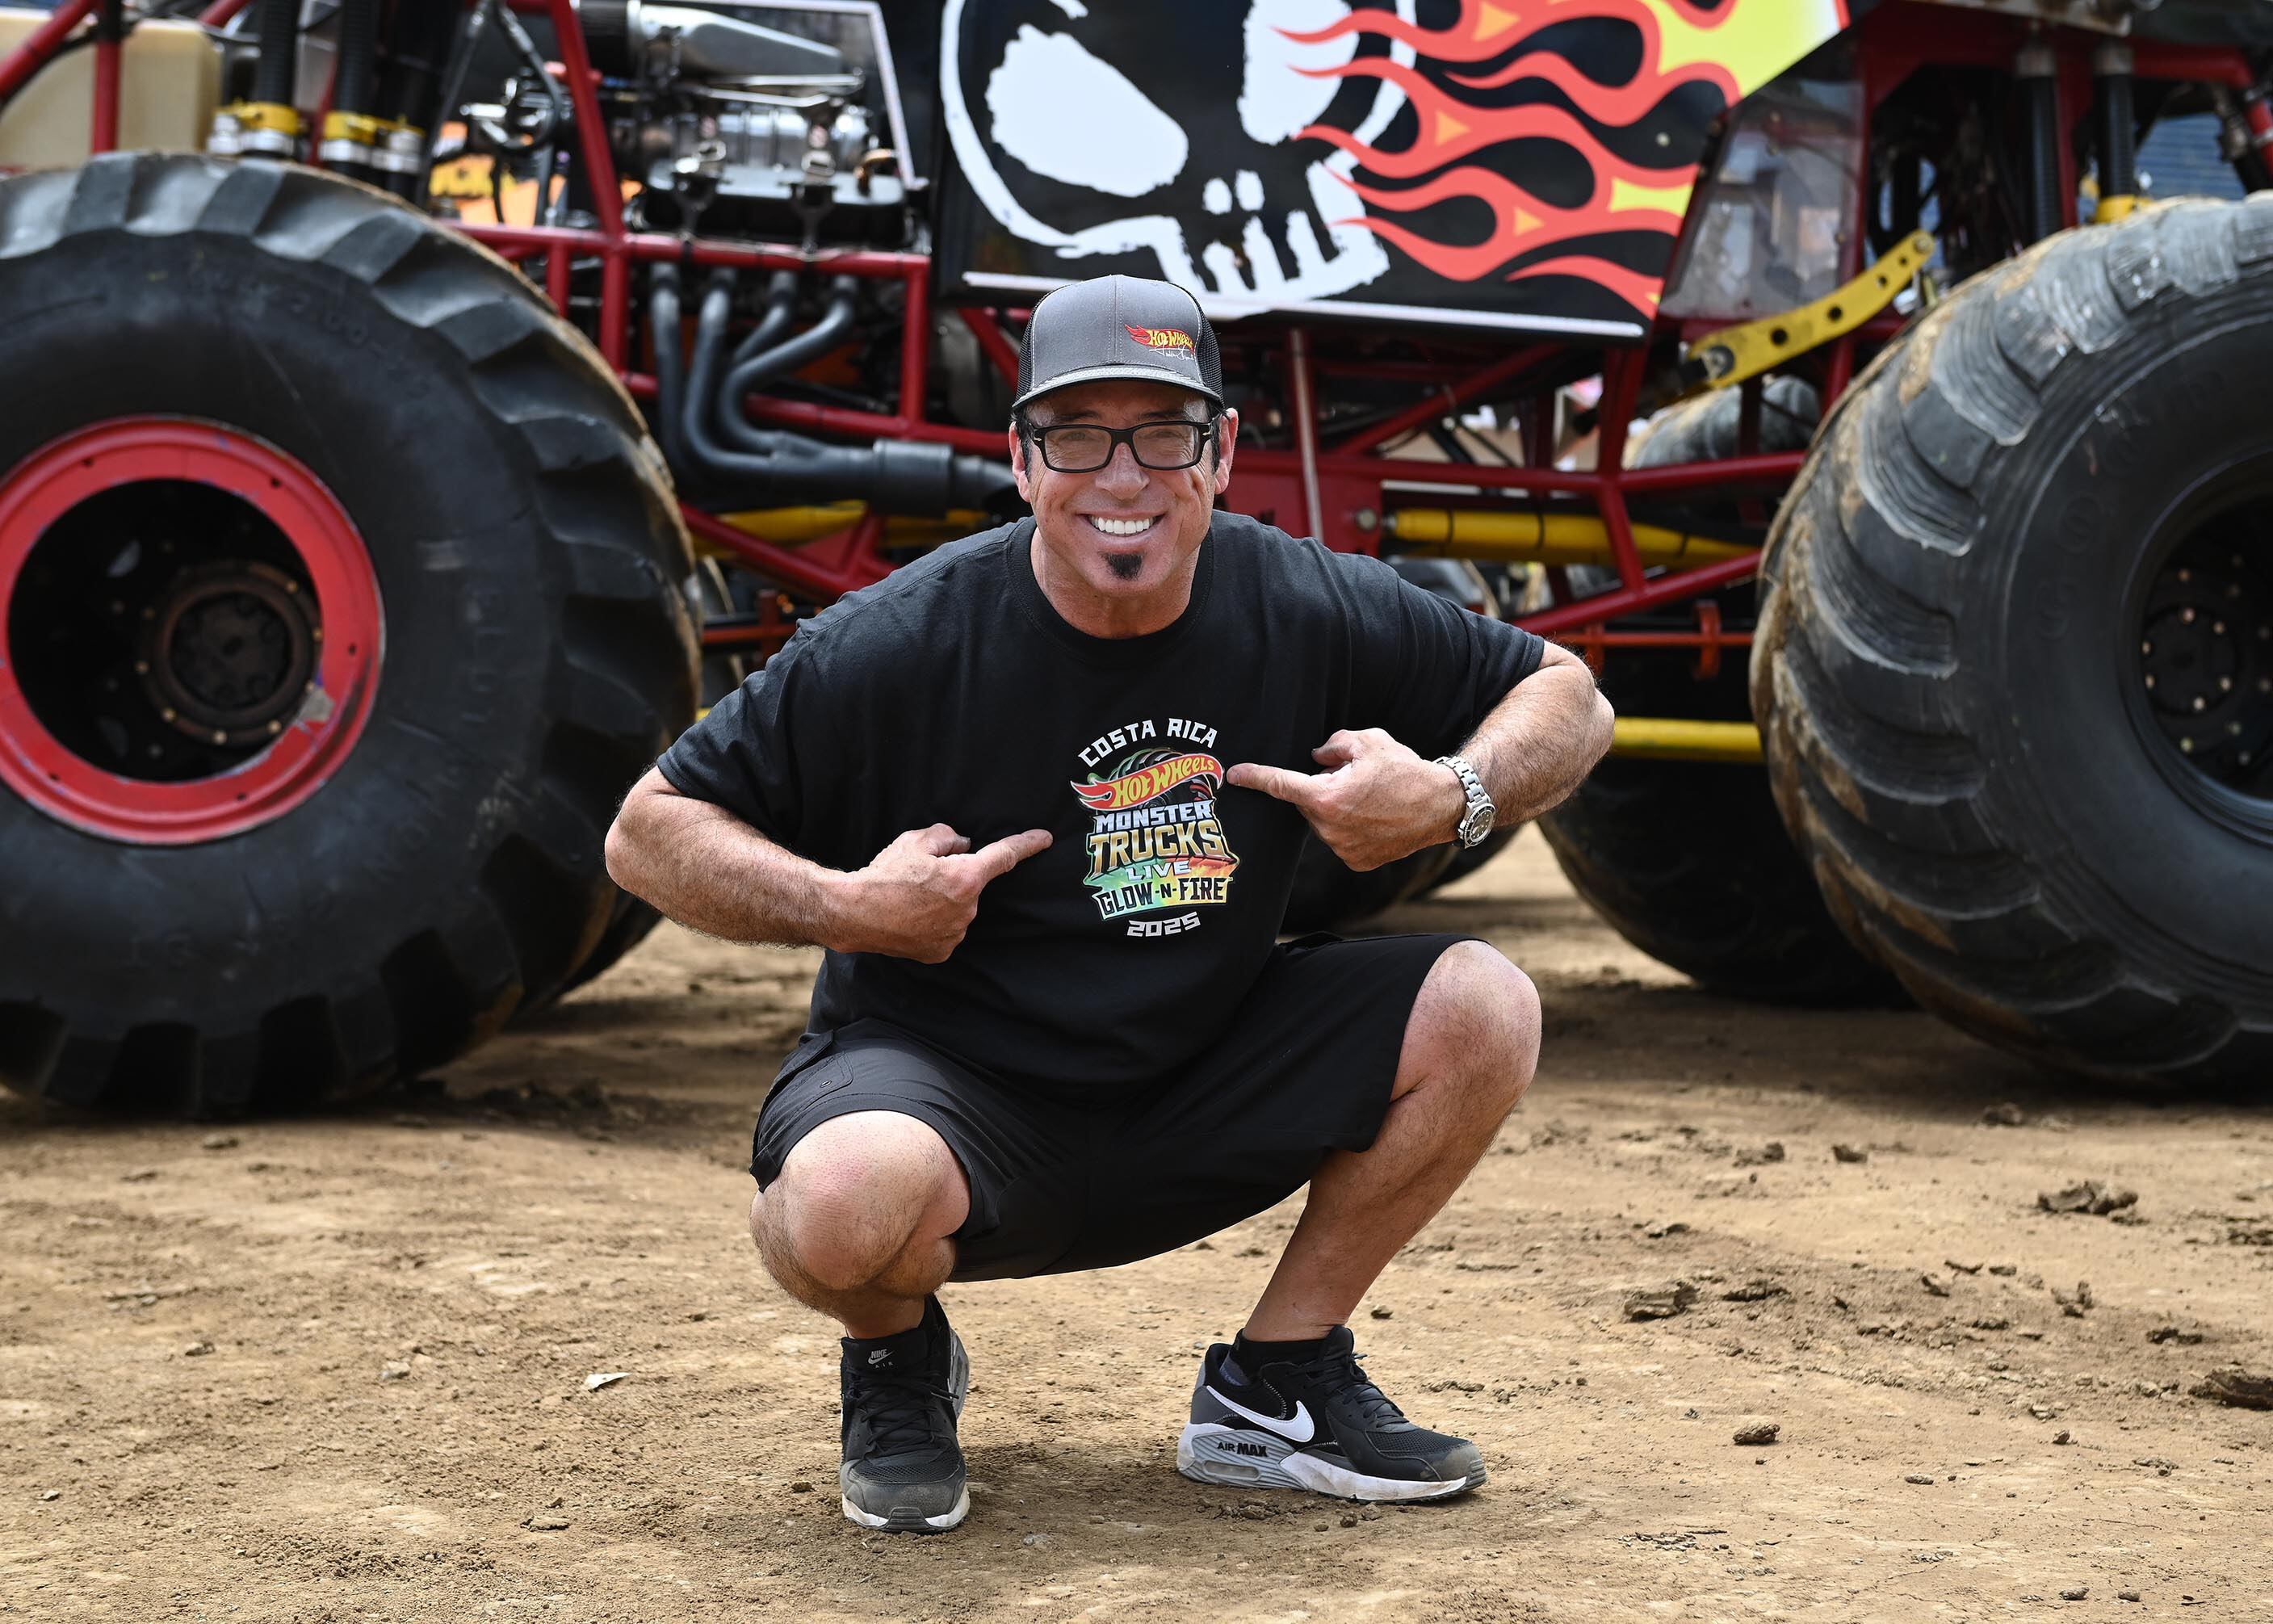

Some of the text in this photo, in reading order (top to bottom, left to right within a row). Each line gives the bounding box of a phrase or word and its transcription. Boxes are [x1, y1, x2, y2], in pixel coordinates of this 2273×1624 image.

[1078, 718, 1218, 767] COSTA RICA
[1109, 774, 1151, 808] HOT
[1093, 799, 1215, 833] MONSTER
[1089, 819, 1231, 876] TRUCKS
[1126, 860, 1192, 881] LIVE
[1126, 911, 1202, 938] 2025
[871, 1349, 887, 1358] NIKE
[1217, 1441, 1269, 1458] AIR MAX
